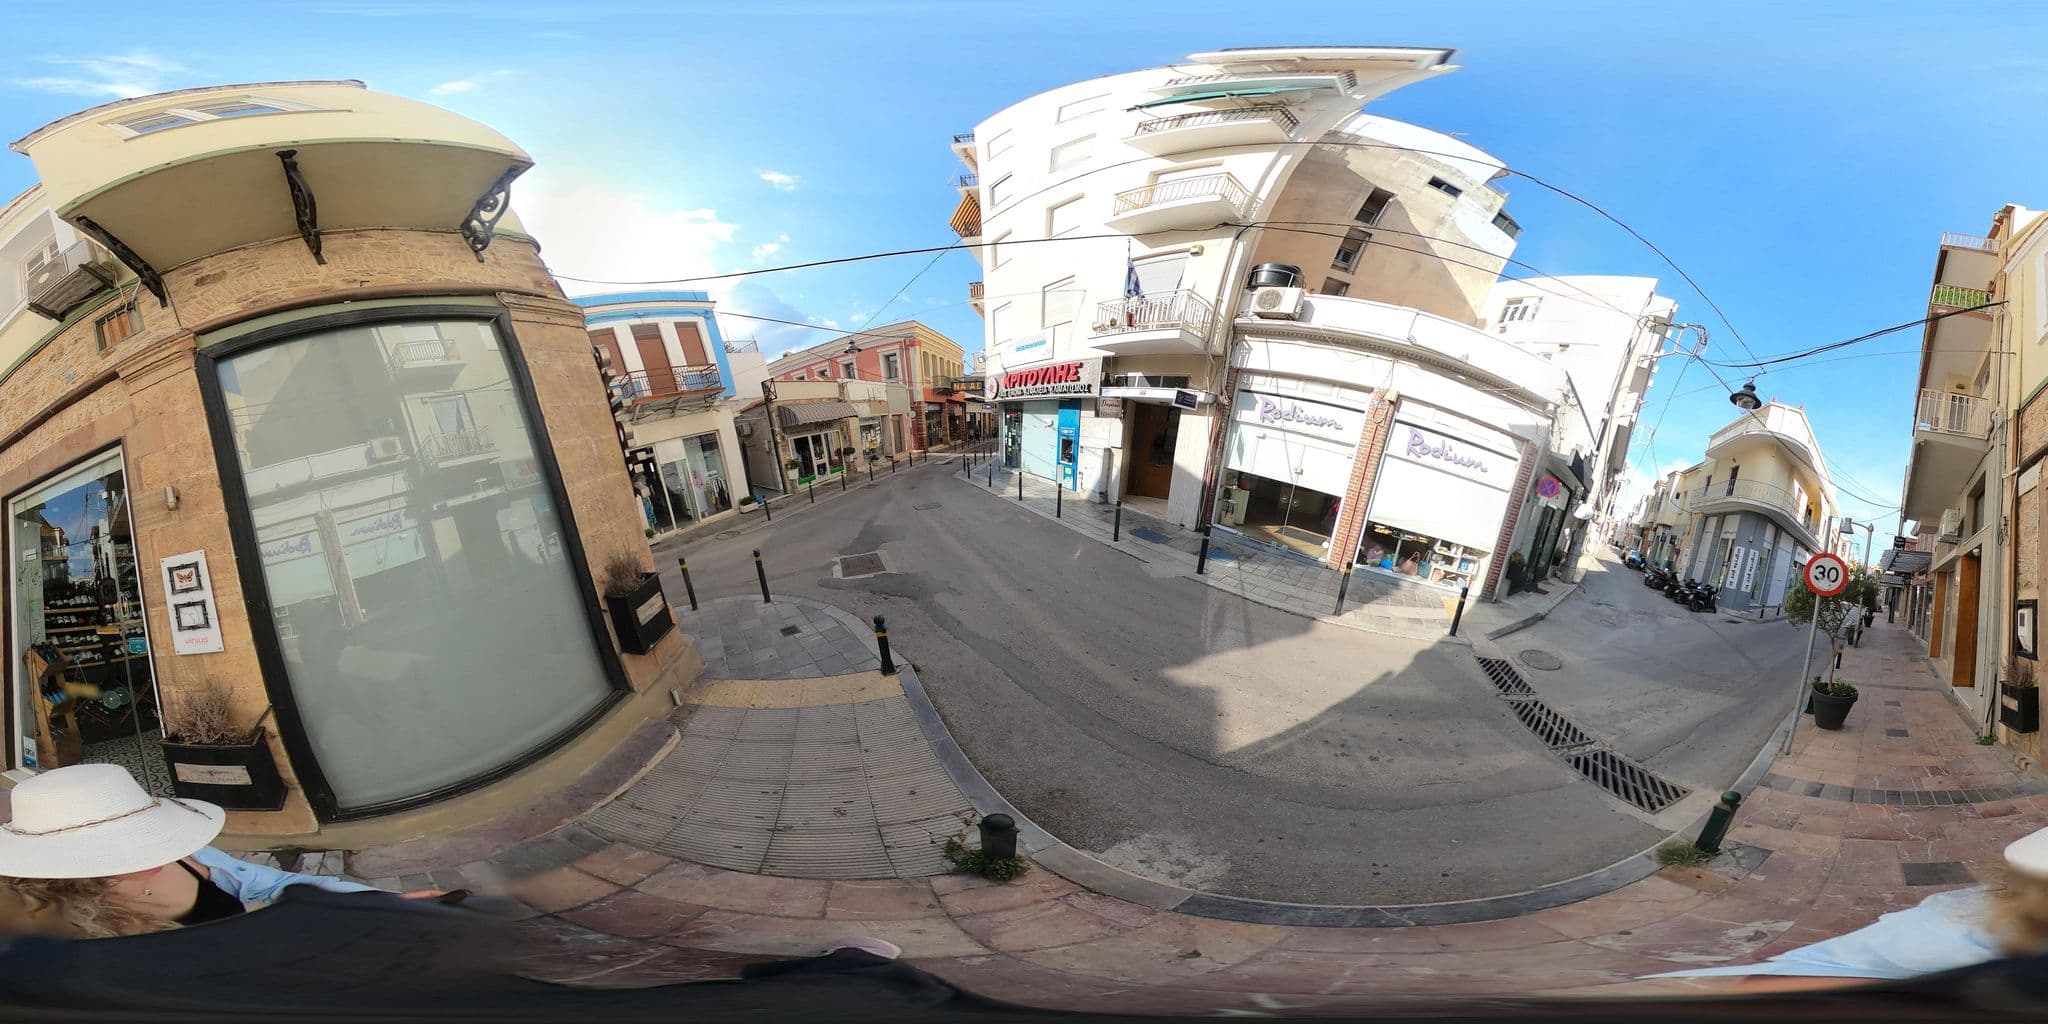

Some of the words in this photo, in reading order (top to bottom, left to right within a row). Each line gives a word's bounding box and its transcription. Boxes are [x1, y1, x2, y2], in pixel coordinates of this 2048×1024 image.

[1003, 362, 1082, 389] ΚΡΙΤΟΥΛΗΣ
[1260, 396, 1343, 430] Rodium
[1406, 427, 1488, 472] Rodium
[1814, 564, 1839, 583] 30
